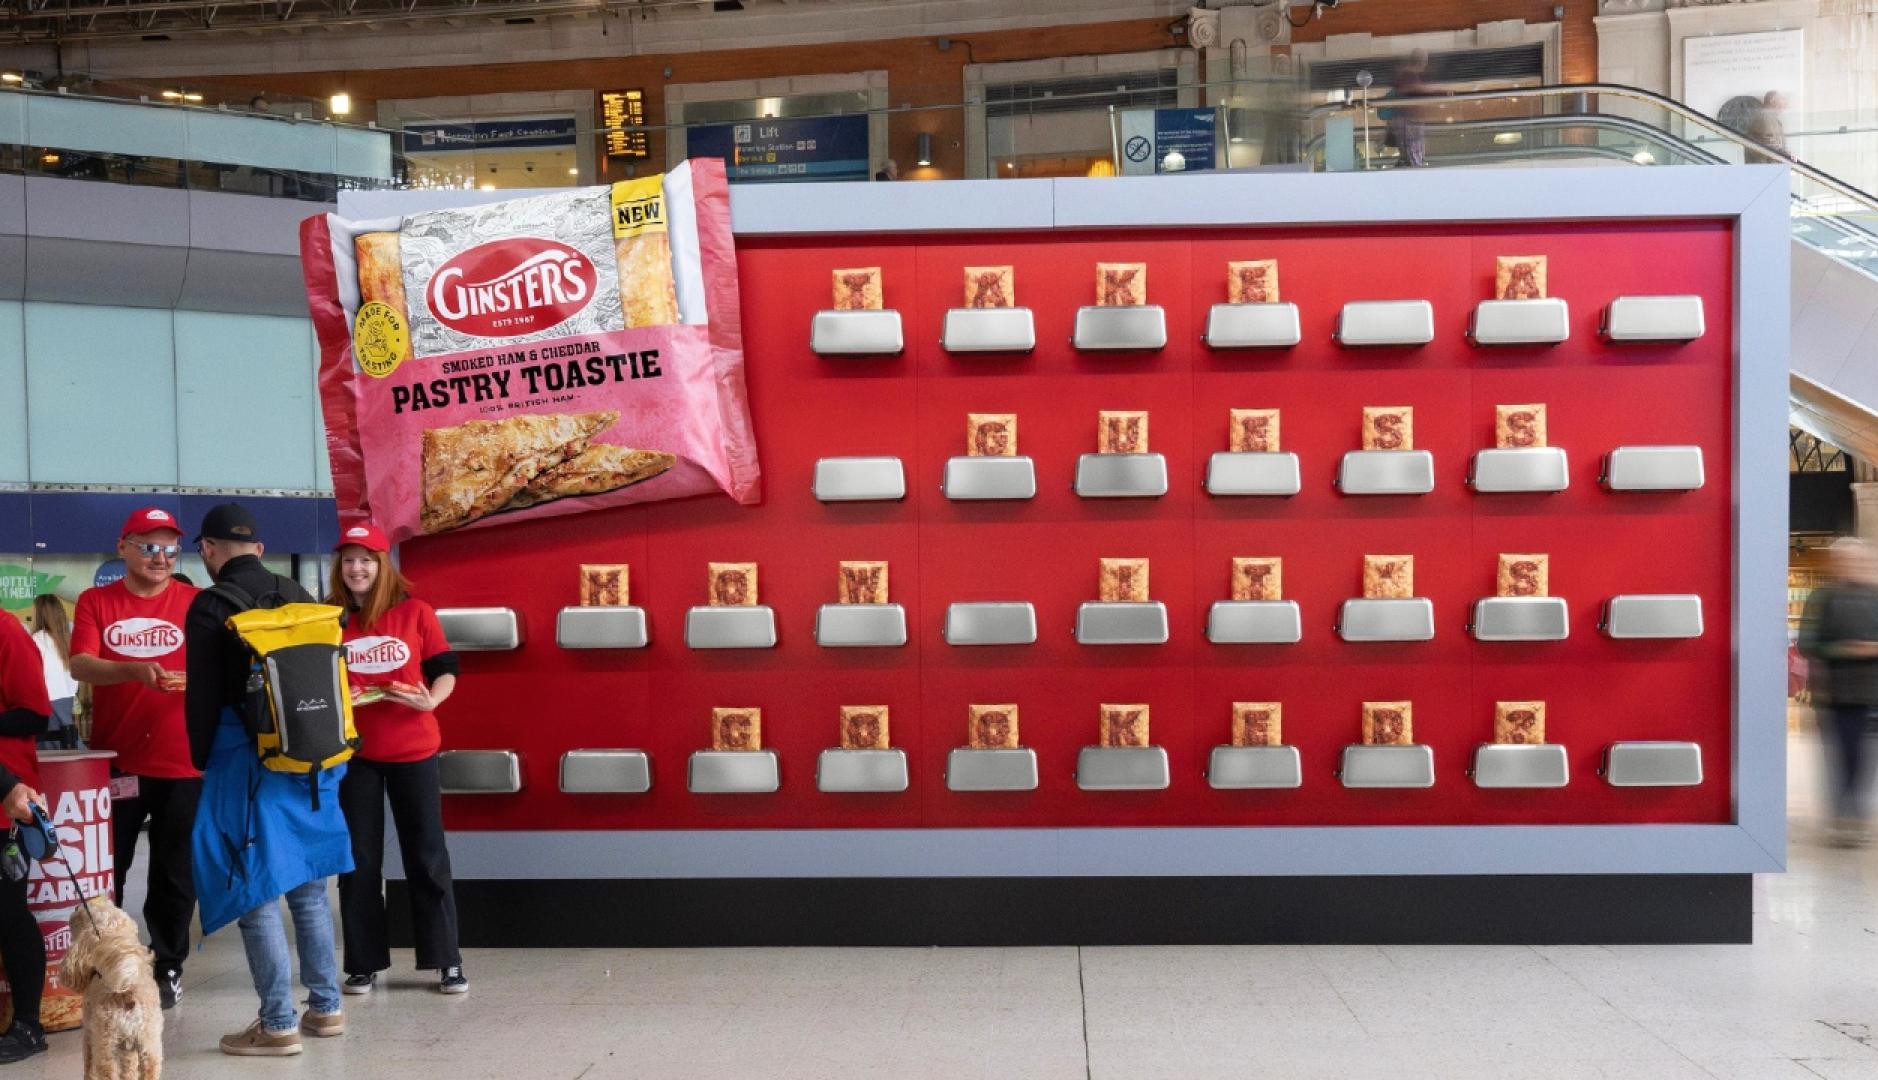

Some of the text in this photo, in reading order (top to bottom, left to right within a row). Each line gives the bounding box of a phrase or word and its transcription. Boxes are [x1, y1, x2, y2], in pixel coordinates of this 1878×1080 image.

[759, 127, 780, 139] Lift
[618, 201, 660, 225] NEW
[433, 249, 588, 320] GINSTERS
[360, 307, 400, 331] MADE FOR
[359, 347, 398, 371] TOASTING
[442, 341, 601, 374] SMOKED HAM & CHEDDAR
[392, 350, 662, 414] PASTRY TOASTIE
[508, 398, 549, 409] BRITISH
[553, 394, 574, 403] HAM
[0, 575, 37, 588] OTTLE
[107, 624, 178, 647] GINSTERS
